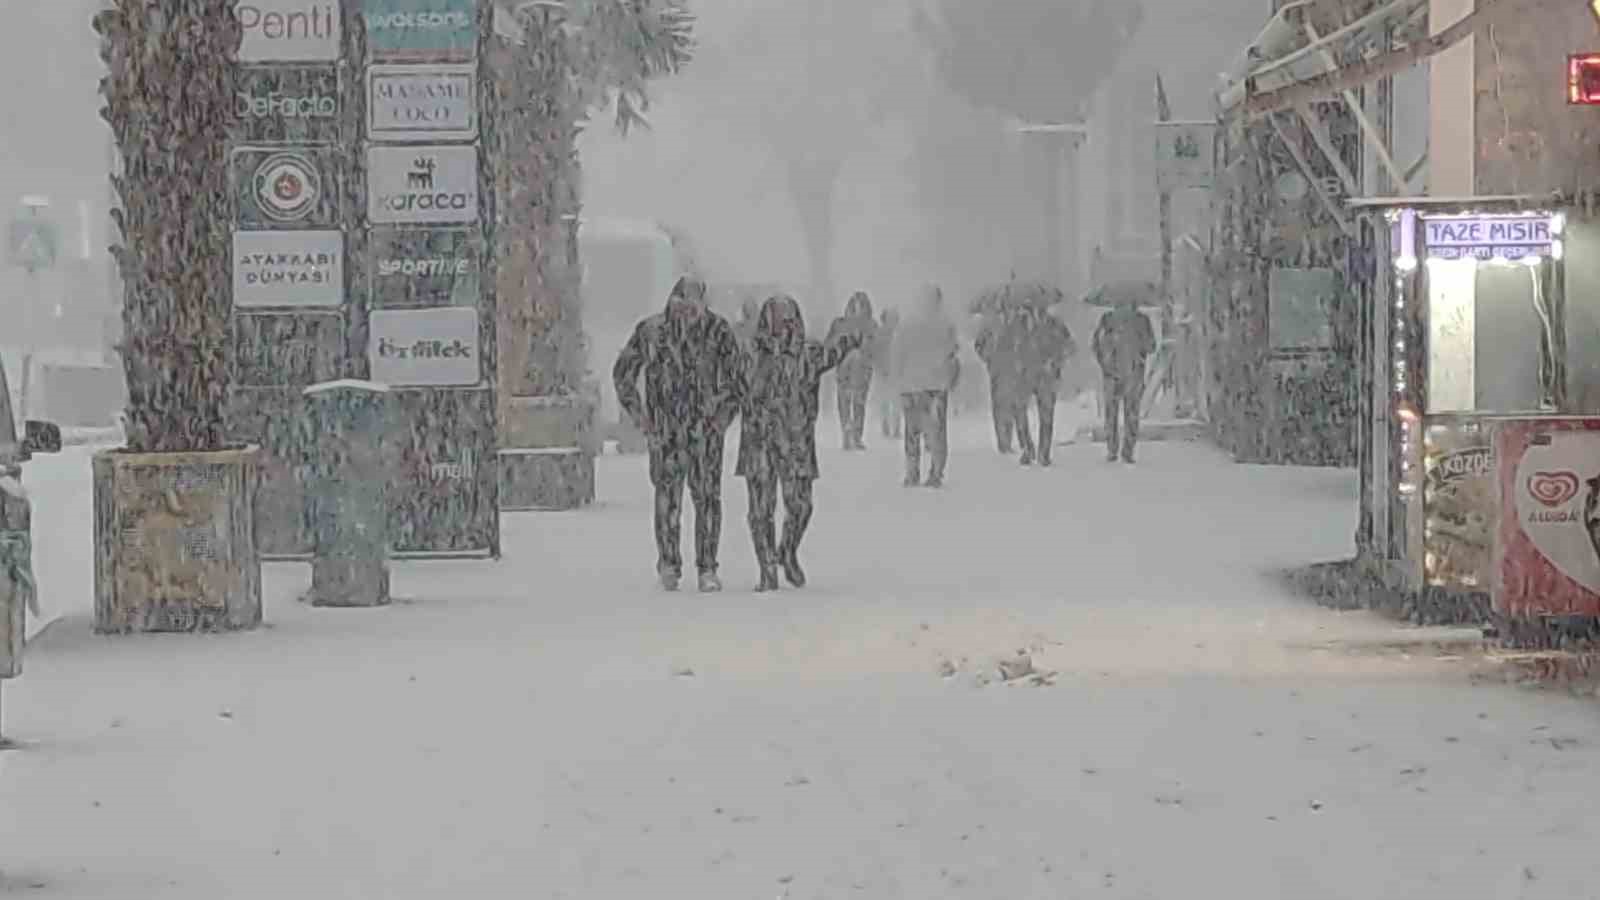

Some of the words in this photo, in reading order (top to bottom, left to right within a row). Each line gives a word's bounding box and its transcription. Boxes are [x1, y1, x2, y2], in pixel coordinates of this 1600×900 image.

[237, 5, 332, 40] Penti
[378, 190, 467, 211] karaca
[1429, 223, 1481, 242] TAZE
[1489, 222, 1549, 241] MISIR
